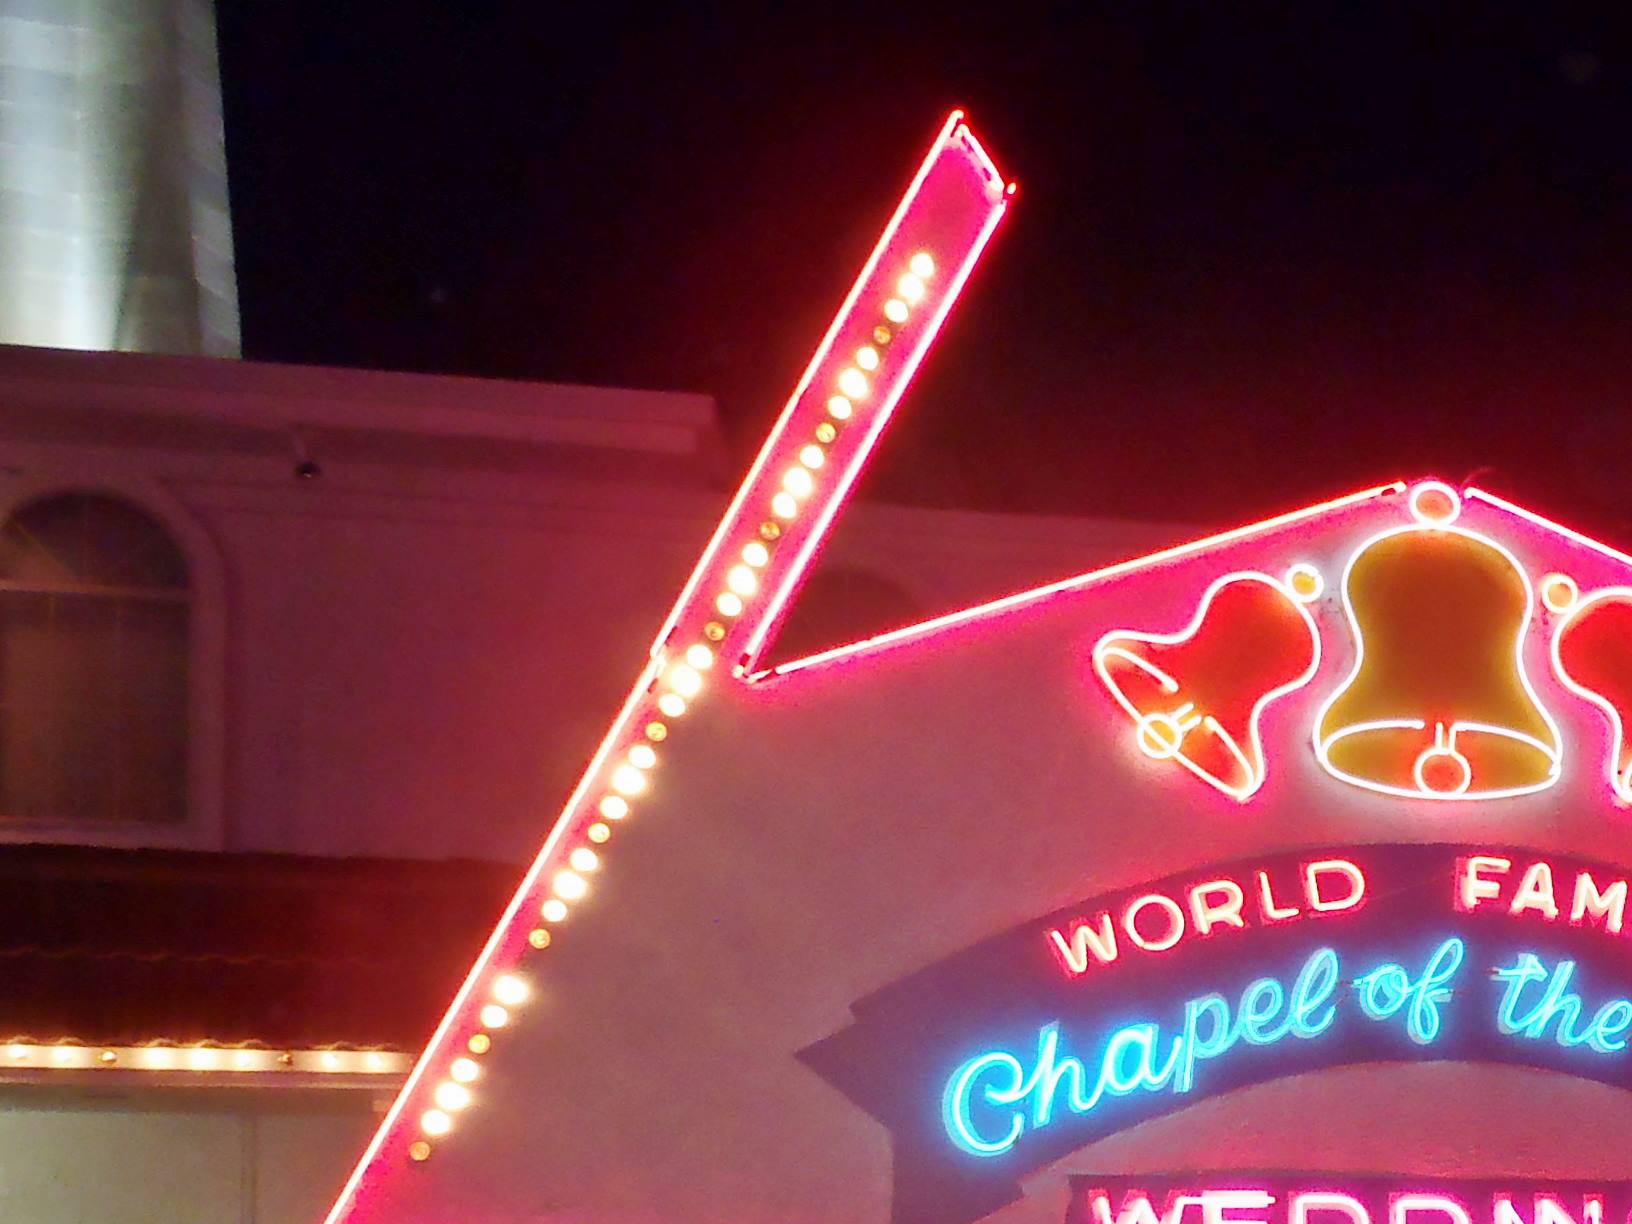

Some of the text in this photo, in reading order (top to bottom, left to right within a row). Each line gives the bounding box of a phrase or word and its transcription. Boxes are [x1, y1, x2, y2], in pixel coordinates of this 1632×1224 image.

[1047, 857, 1369, 975] WORLD
[942, 946, 1342, 1158] Chapel
[1352, 937, 1466, 1045] of
